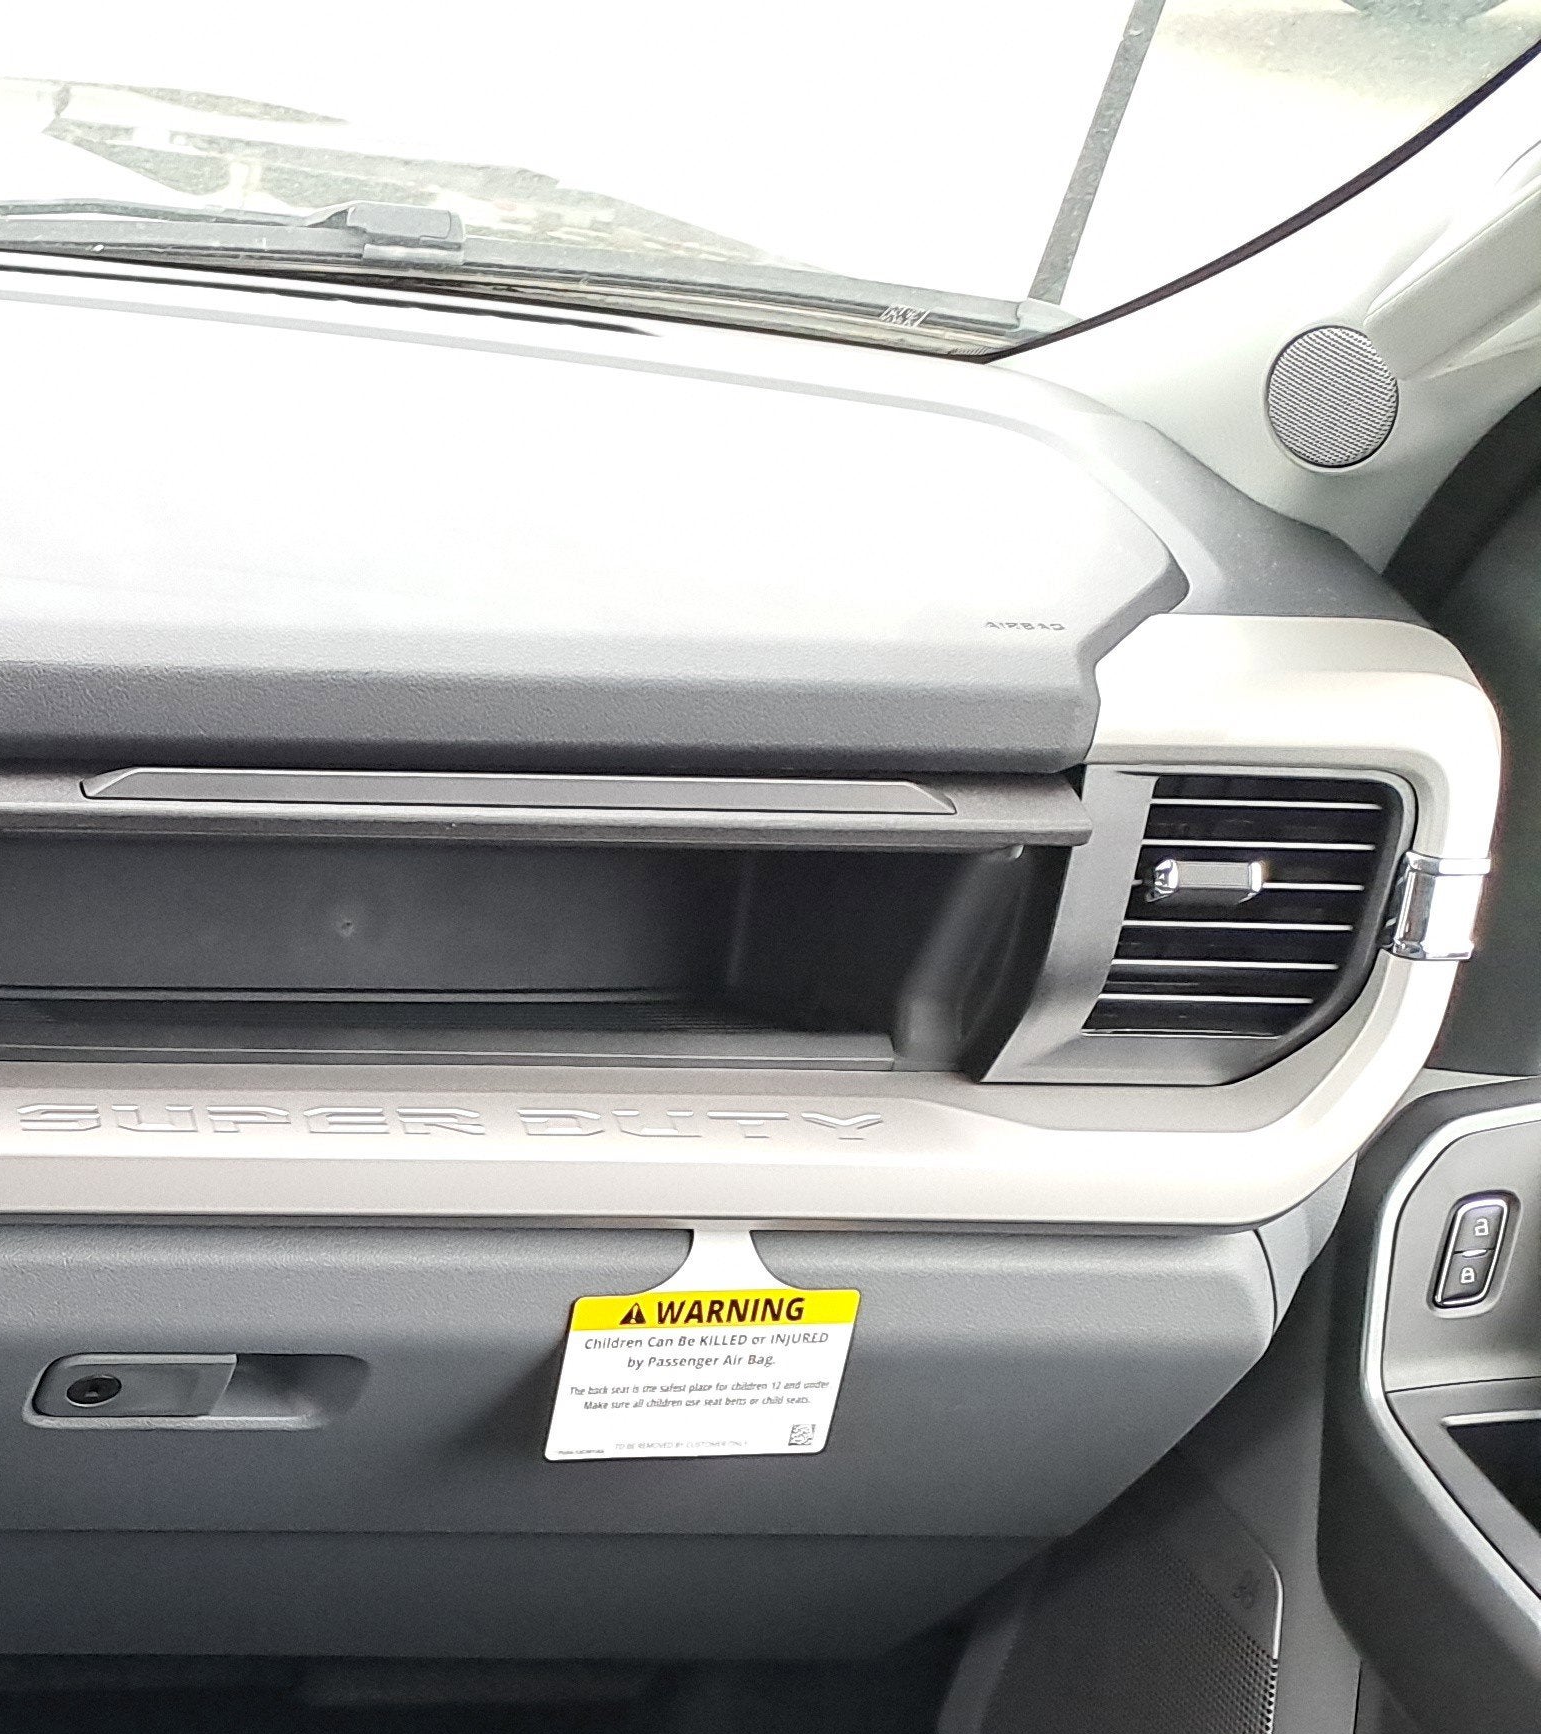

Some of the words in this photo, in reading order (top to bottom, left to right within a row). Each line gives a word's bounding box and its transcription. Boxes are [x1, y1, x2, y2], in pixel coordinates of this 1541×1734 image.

[15, 1102, 488, 1136] SUPER
[516, 1106, 882, 1141] DUTY
[656, 1296, 806, 1325] WARNING
[584, 1337, 643, 1350] Children
[647, 1336, 674, 1348] Can
[678, 1335, 695, 1347] Be
[699, 1334, 748, 1347] KILLED
[751, 1336, 767, 1345] or
[771, 1332, 829, 1347] INJURED
[627, 1356, 644, 1371] by
[647, 1355, 720, 1370] Passenger
[722, 1354, 744, 1366] Air
[747, 1354, 776, 1368] Bag.
[570, 1386, 585, 1396] The
[611, 1385, 630, 1395] seat
[632, 1385, 639, 1394] is
[660, 1382, 687, 1393] safest
[688, 1382, 713, 1394] place
[715, 1382, 728, 1391] for
[731, 1381, 768, 1391] children
[783, 1380, 802, 1390] and
[583, 1401, 609, 1410] Make
[611, 1401, 630, 1410] sure
[632, 1398, 644, 1409] all
[646, 1398, 683, 1408] children
[704, 1398, 723, 1406] seat
